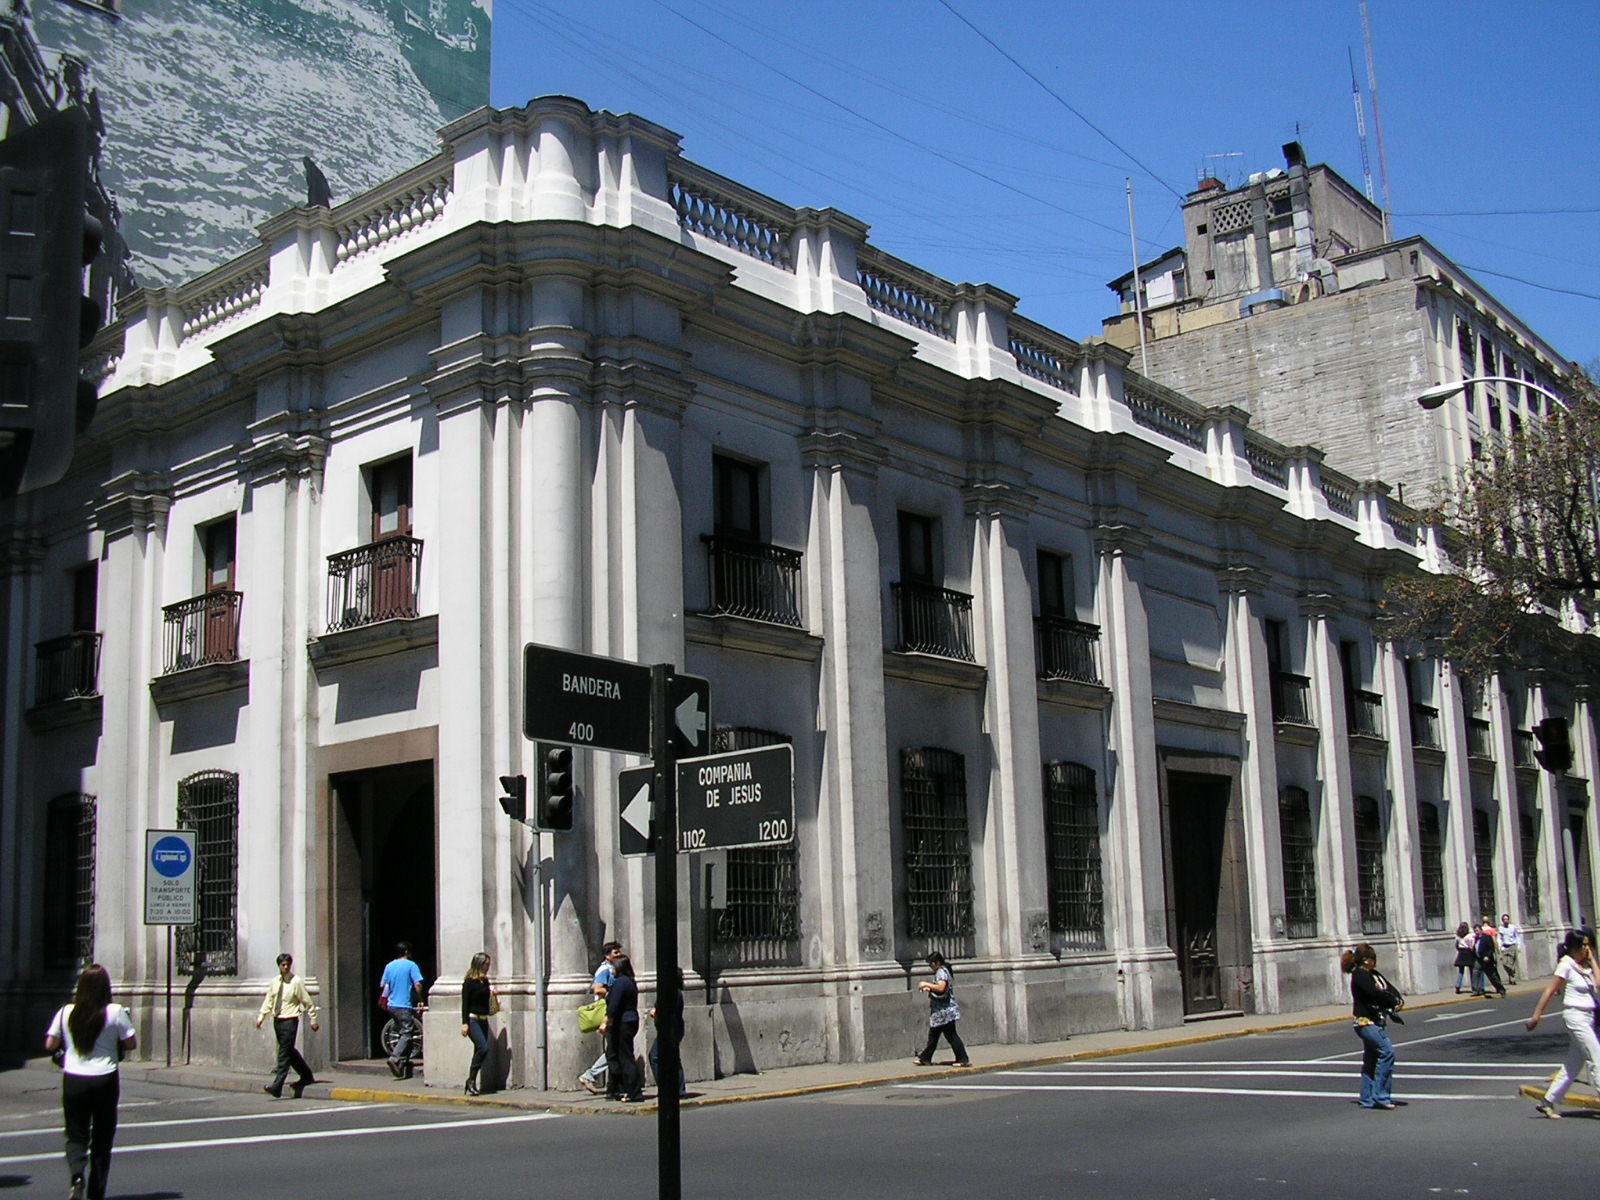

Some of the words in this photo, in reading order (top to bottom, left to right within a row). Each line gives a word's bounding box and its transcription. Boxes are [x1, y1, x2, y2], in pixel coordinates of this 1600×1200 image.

[563, 673, 621, 700] BANDERA
[569, 722, 594, 742] 400
[706, 789, 720, 808] DE
[728, 783, 762, 806] JESUS
[683, 828, 706, 848] 1102
[759, 819, 788, 841] 1200
